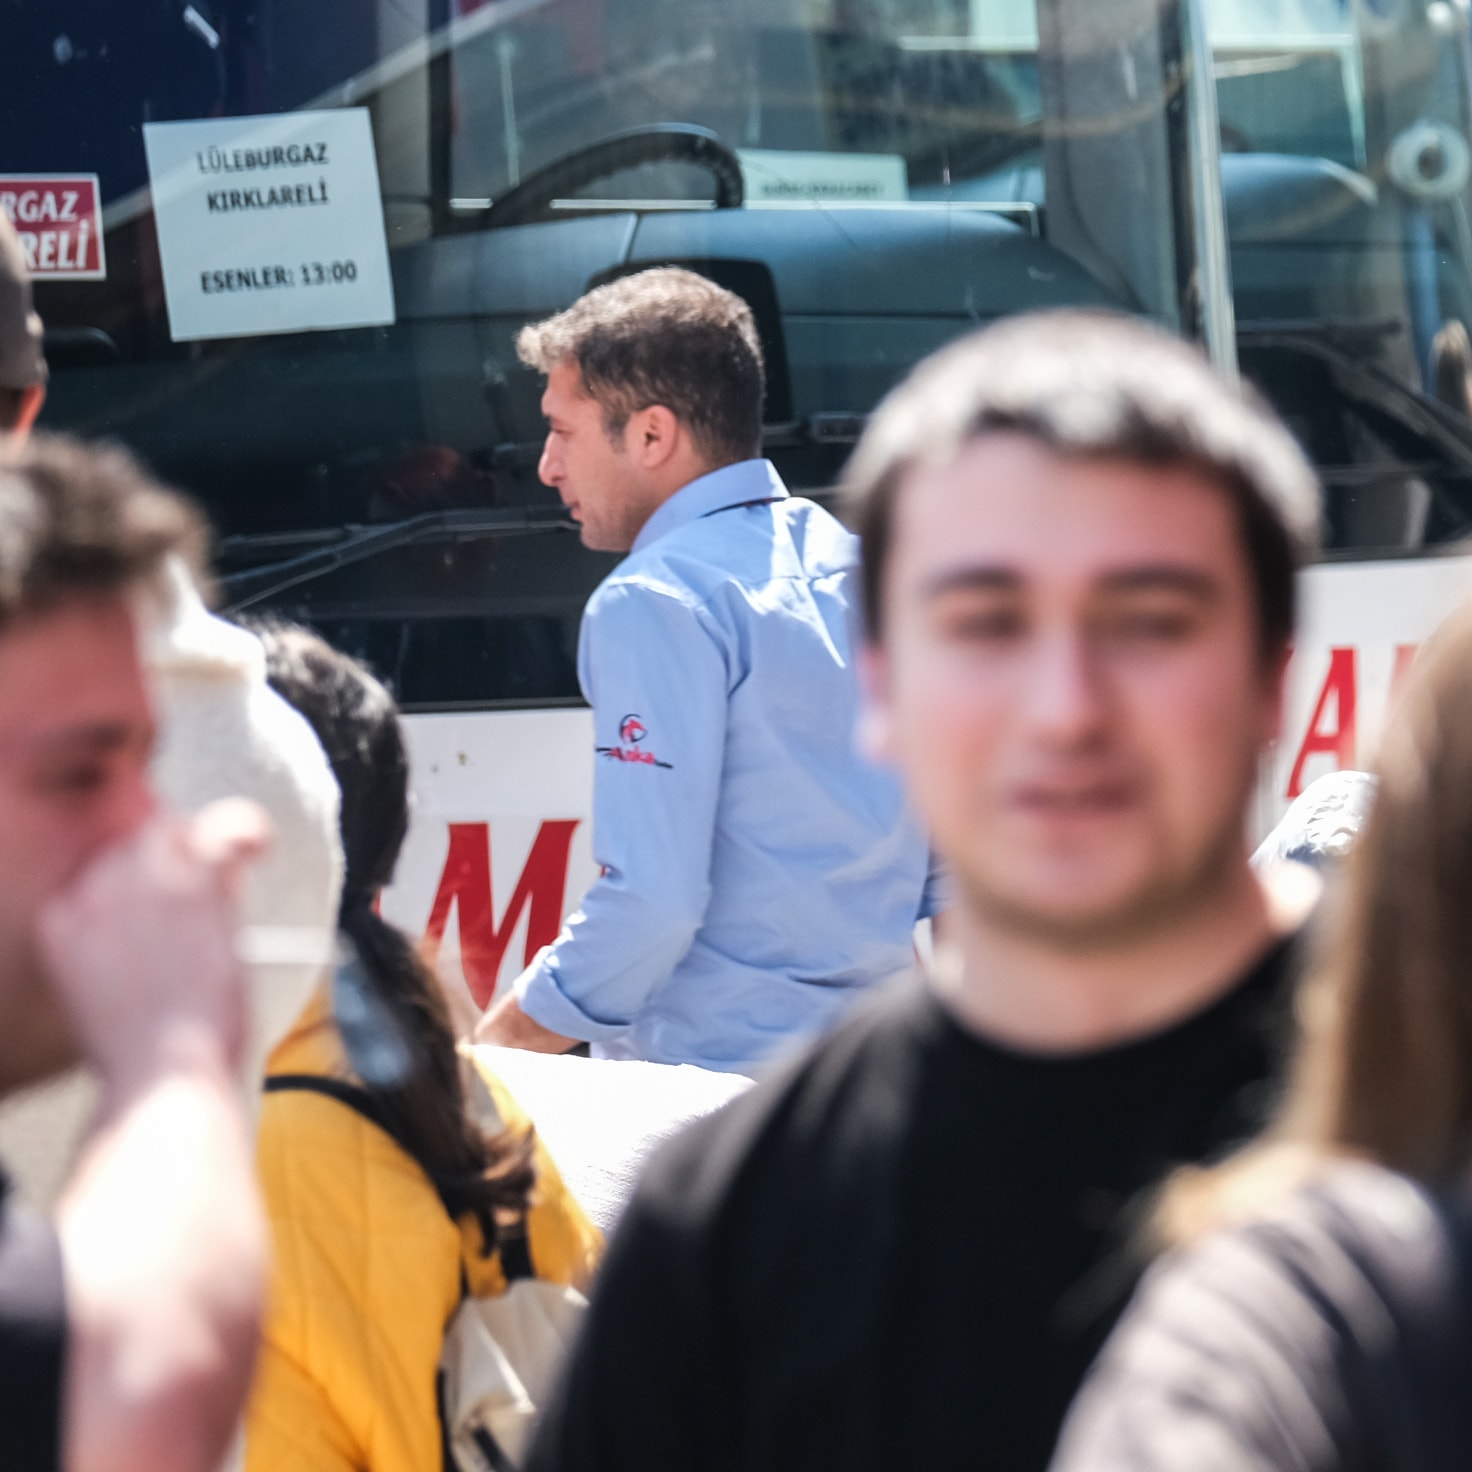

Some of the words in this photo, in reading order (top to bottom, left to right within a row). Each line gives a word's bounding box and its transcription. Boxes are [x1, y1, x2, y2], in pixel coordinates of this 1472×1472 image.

[197, 141, 328, 174] LÜLEBURGAZ
[207, 176, 329, 213] KIRKLARELİ
[302, 260, 357, 287] 13:00
